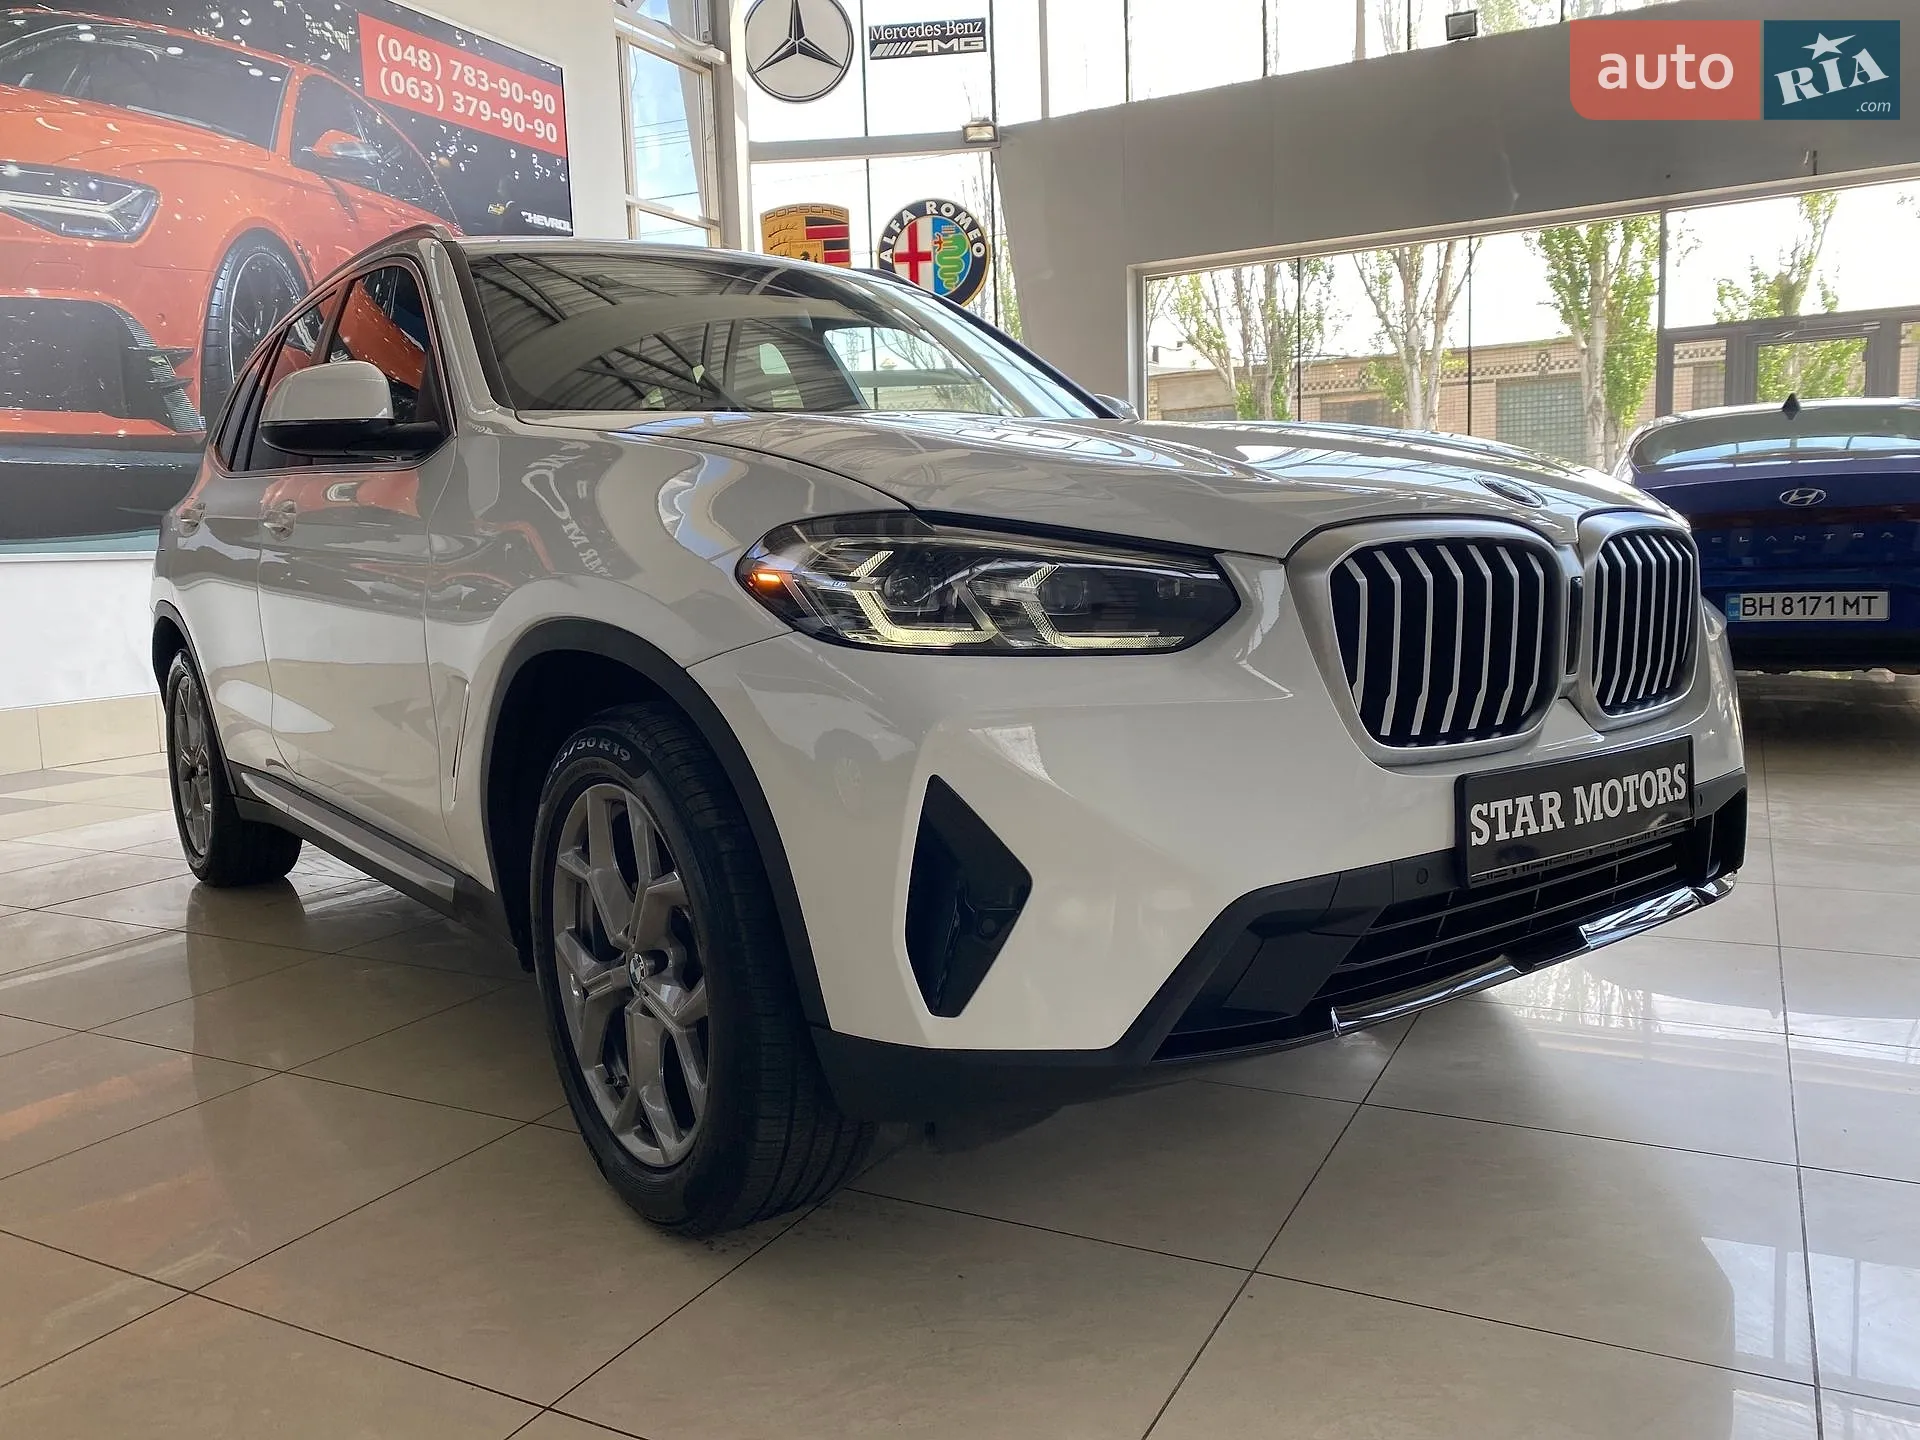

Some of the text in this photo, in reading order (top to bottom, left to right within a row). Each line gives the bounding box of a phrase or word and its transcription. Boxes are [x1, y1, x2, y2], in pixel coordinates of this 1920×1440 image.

[870, 20, 983, 41] Mercedes-Benz
[377, 34, 556, 114] (048) 783-90-90
[380, 67, 558, 143] (063) 379-90-90
[764, 205, 845, 221] PORSCHE
[880, 200, 986, 265] ALFA ROMEO
[1711, 531, 1894, 543] ELANTRA
[1742, 595, 1879, 616] BH 8171 MT
[1470, 762, 1687, 847] STAR MOTORS
